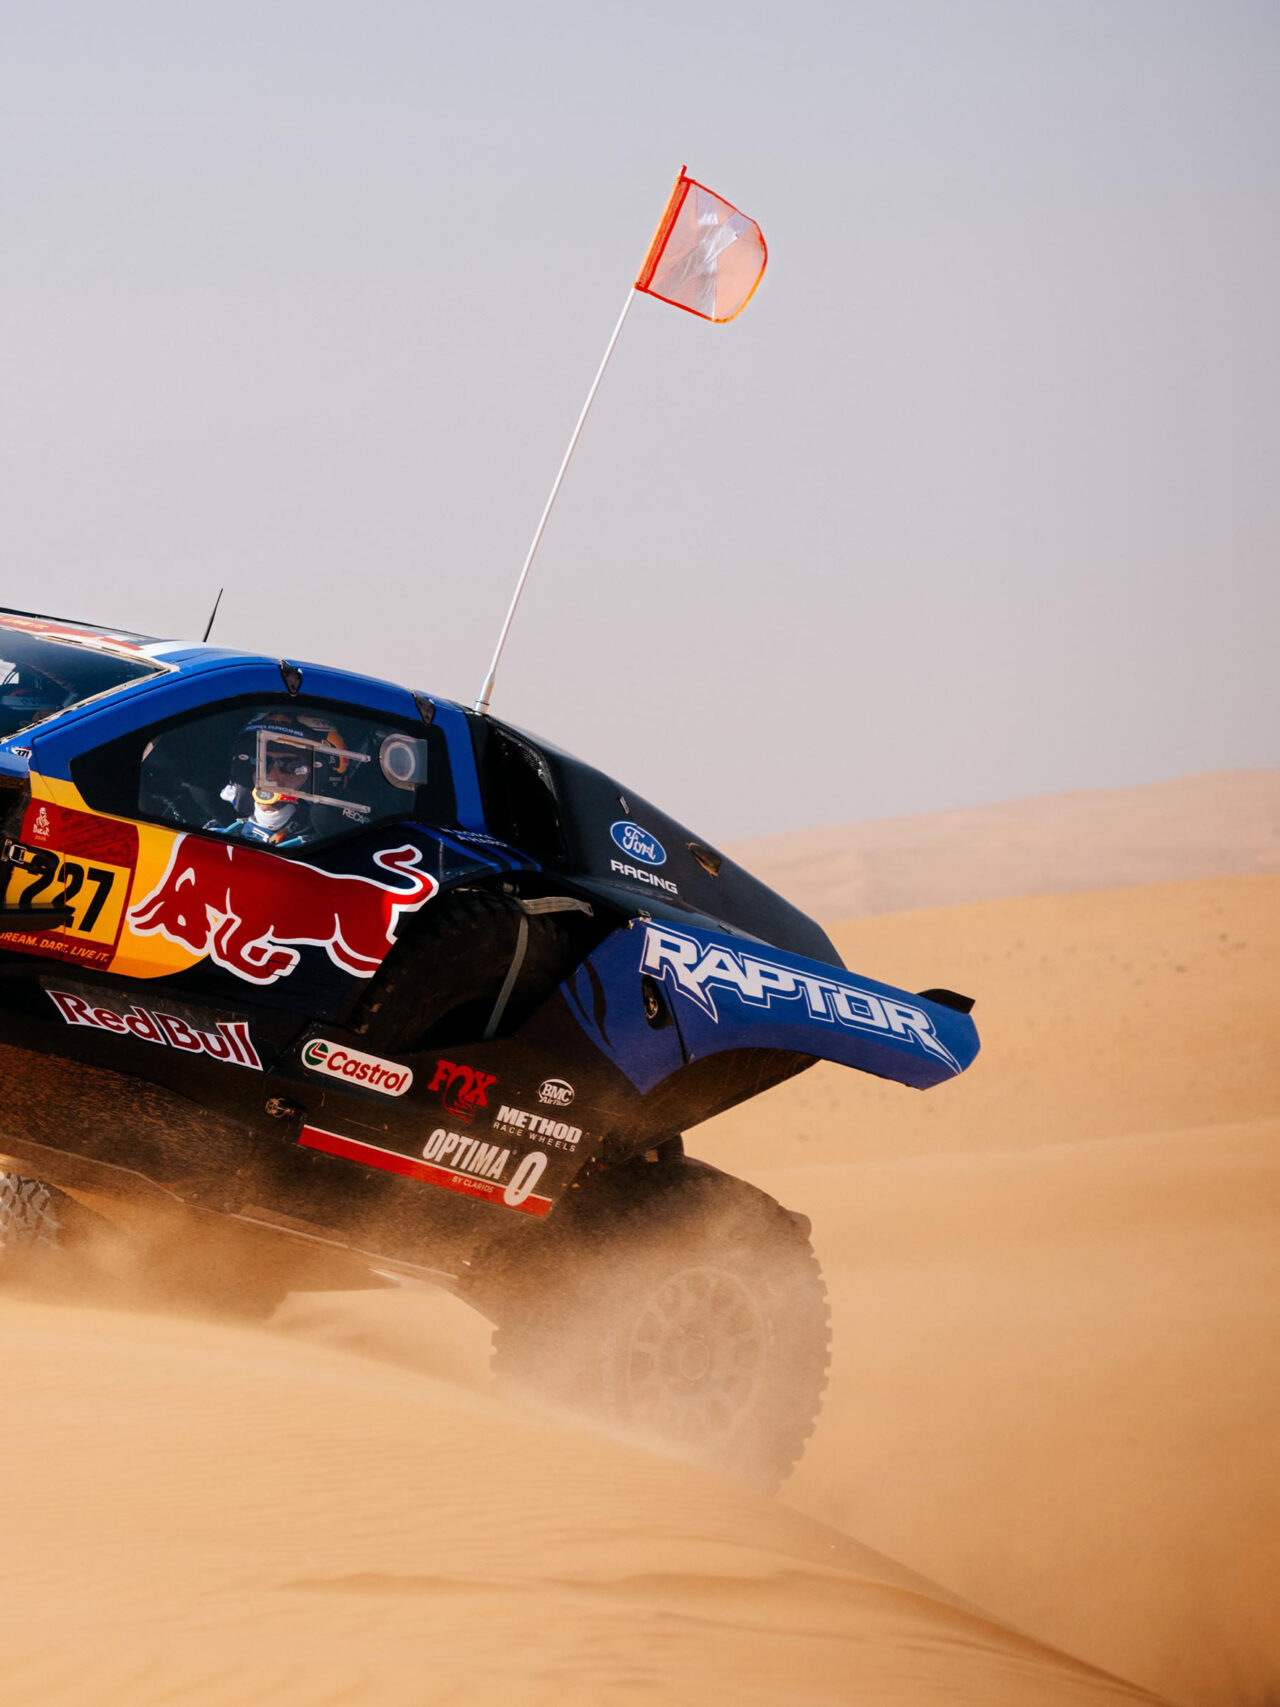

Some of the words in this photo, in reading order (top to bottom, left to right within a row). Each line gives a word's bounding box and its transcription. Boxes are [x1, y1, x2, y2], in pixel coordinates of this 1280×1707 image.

[622, 826, 656, 860] Ford
[18, 848, 115, 933] 227
[610, 860, 679, 895] RACING
[70, 946, 96, 959] LIVE
[640, 923, 962, 1074] RAPTOR
[45, 989, 168, 1045] Red
[151, 1011, 264, 1071] Bull
[326, 1050, 409, 1092] Castrol
[427, 1059, 497, 1111] FOX
[541, 1083, 572, 1102] BMC
[493, 1122, 523, 1137] RACE
[529, 1133, 577, 1153] WHEELS
[496, 1105, 583, 1144] METHOD
[422, 1128, 511, 1180] OPTIMA
[452, 1175, 464, 1187] BY
